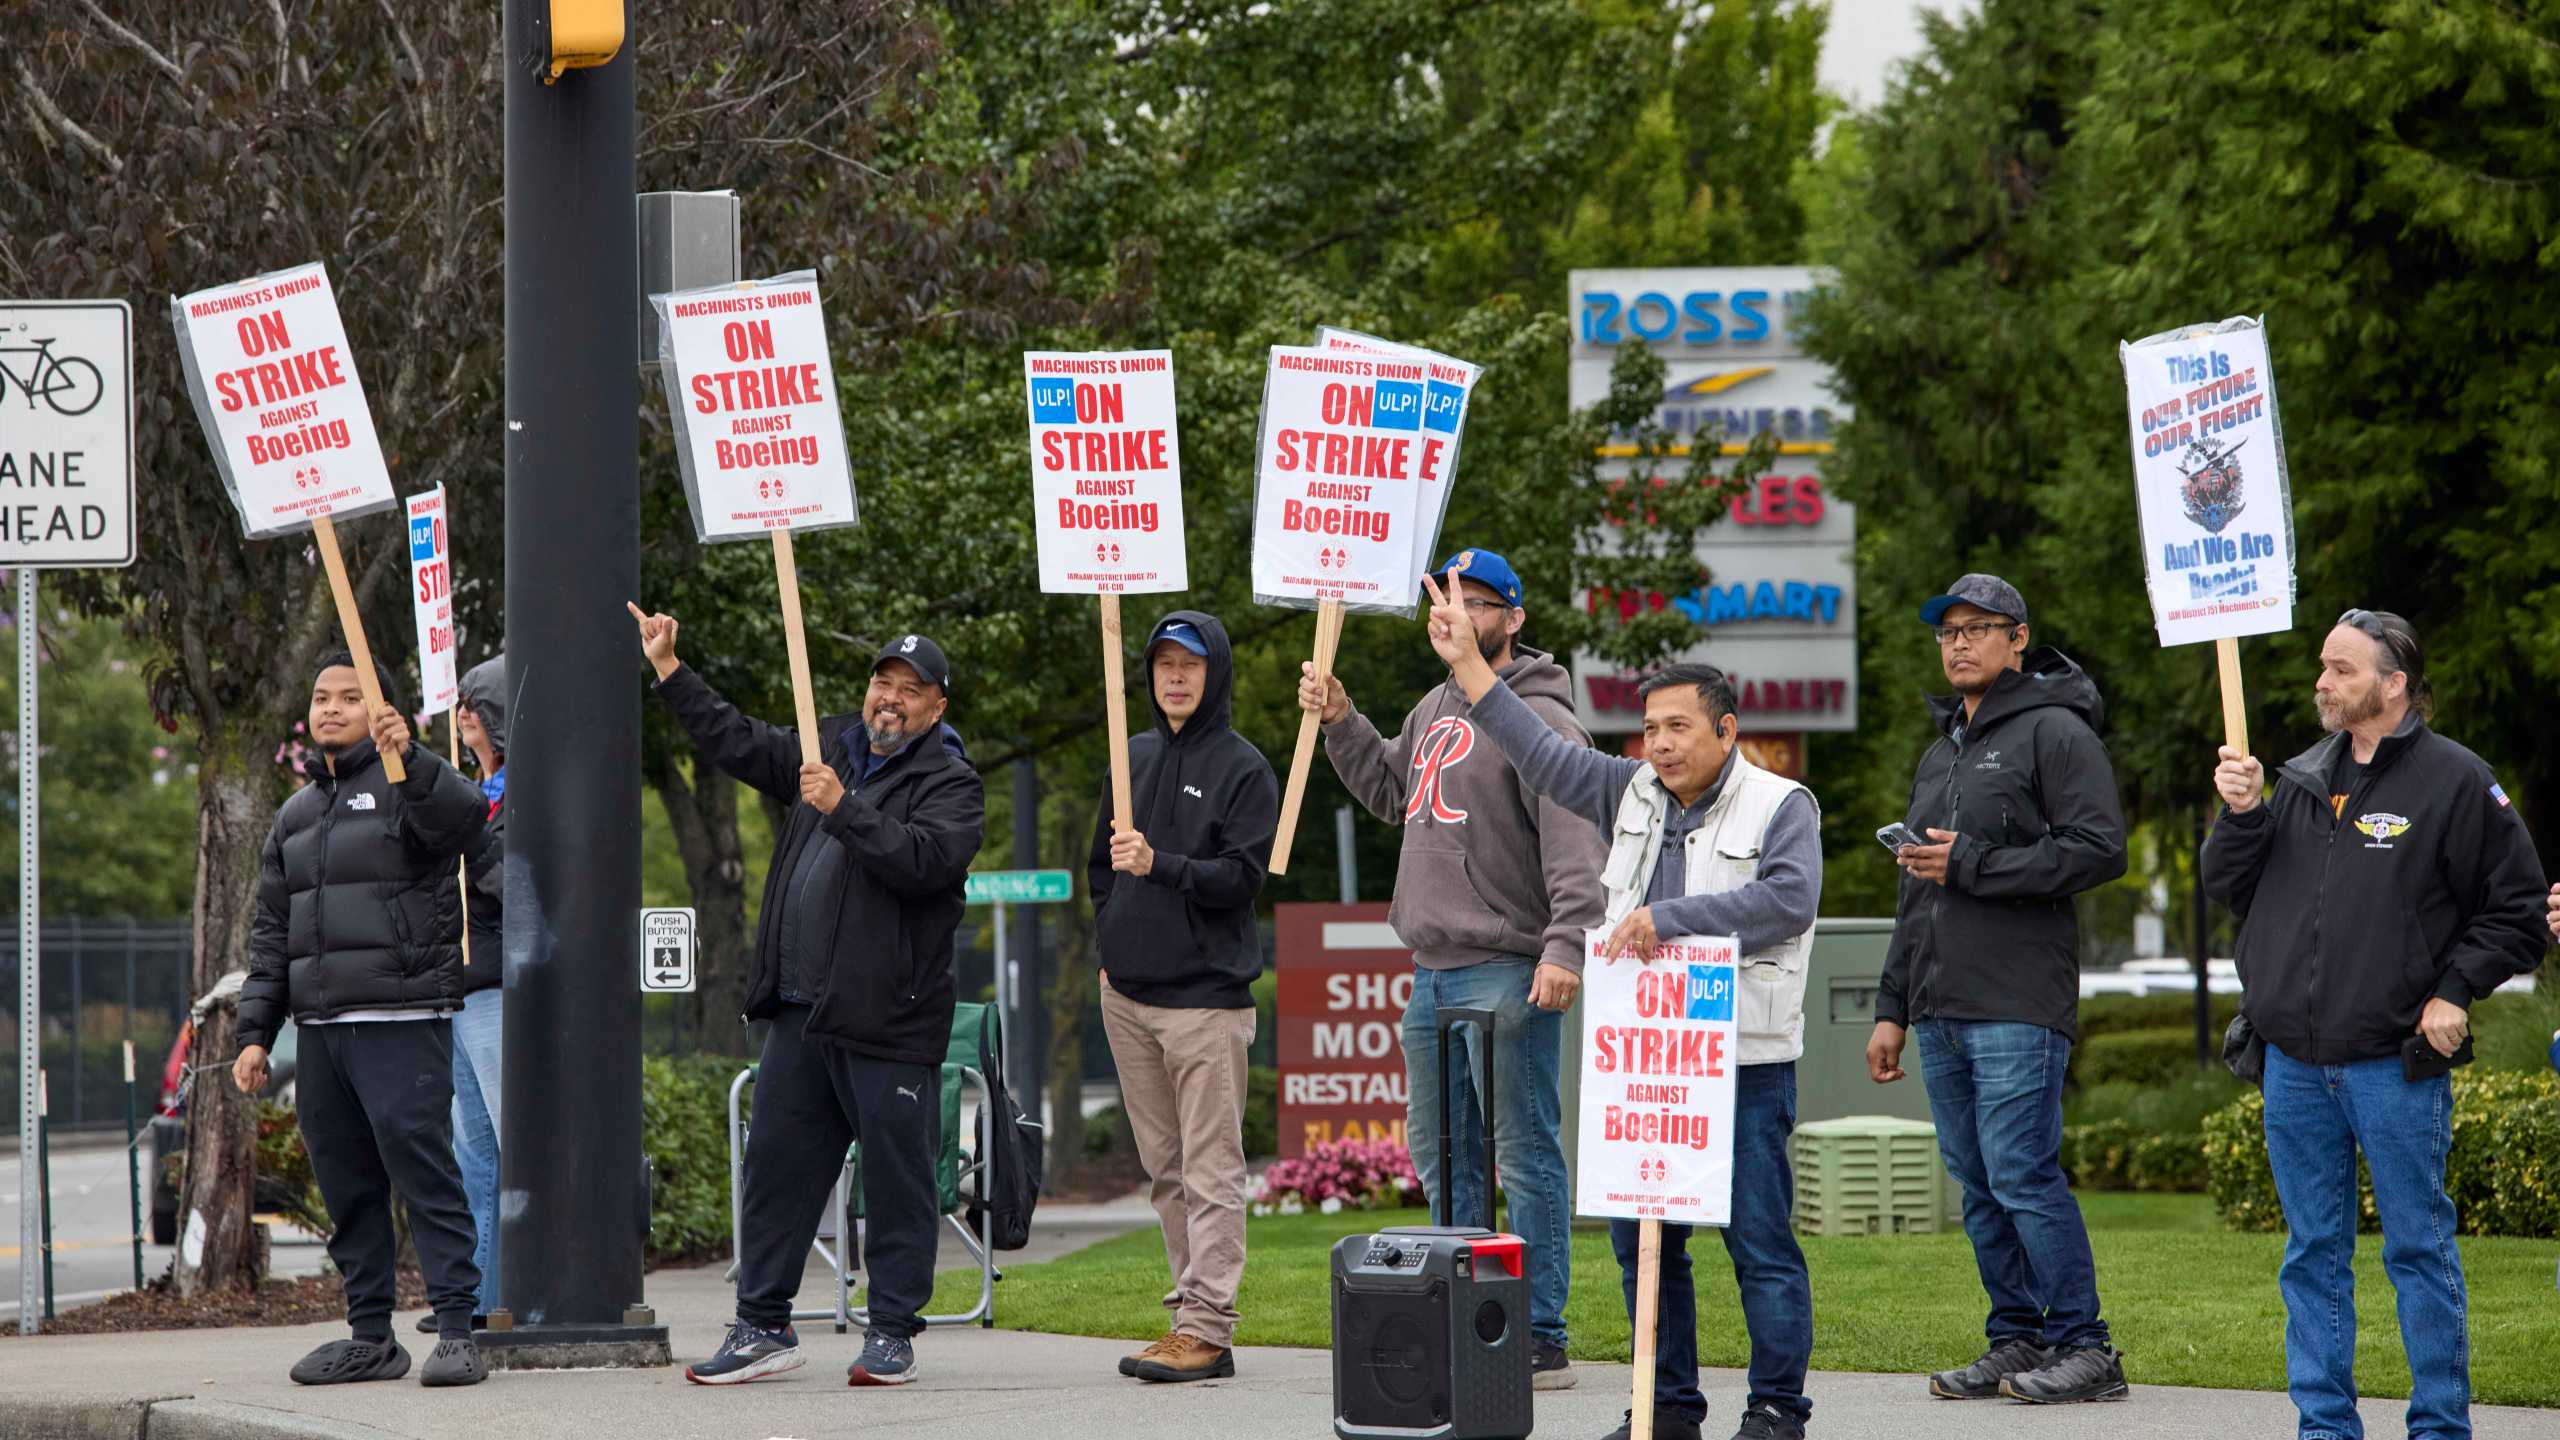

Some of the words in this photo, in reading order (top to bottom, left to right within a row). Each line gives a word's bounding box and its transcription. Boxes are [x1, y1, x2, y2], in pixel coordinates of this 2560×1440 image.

[191, 288, 273, 318] MACHINISTS
[276, 275, 321, 298] UNION
[675, 296, 764, 318] MACHINISTS
[767, 291, 812, 308] UNION
[1582, 290, 1769, 342] ROSS
[237, 310, 292, 357] ON
[723, 319, 775, 363] ON
[215, 346, 346, 413] STRIKE
[1032, 358, 1117, 374] MACHINISTS
[1121, 357, 1166, 373] UNION
[1279, 354, 1372, 376] MACHINISTS
[1376, 363, 1422, 380] UNION
[1428, 361, 1467, 384] NION
[2166, 353, 2207, 385] This
[2210, 350, 2231, 378] Is
[691, 363, 823, 414] STRIKE
[1036, 387, 1071, 407] ULP!
[1075, 382, 1124, 424] ON
[1378, 391, 1417, 413] ULP!
[2142, 397, 2183, 433] OUR
[2186, 367, 2257, 416] FUTURE
[259, 401, 319, 429] AGAINST
[1321, 383, 1374, 428] ON
[732, 414, 792, 435] AGAINST
[1664, 409, 1831, 438] FITNESS
[2144, 421, 2194, 458] OUR
[2199, 393, 2264, 438] FIGHT
[247, 419, 351, 466] Boeing
[715, 435, 820, 470] Boeing
[1042, 429, 1169, 472] STRIKE
[1276, 429, 1410, 481] STRIKE
[0, 452, 86, 488] ANE
[1075, 479, 1135, 496] AGAINST
[1307, 481, 1372, 502] AGAINST
[0, 505, 106, 542] EAD
[758, 508, 788, 518] DISTRICT
[789, 505, 810, 516] LODGE
[1058, 497, 1159, 532] Boeing
[1282, 498, 1390, 543] Boeing
[412, 526, 432, 545] ULP!
[2164, 541, 2201, 572] And
[2203, 532, 2237, 565] We
[2241, 533, 2275, 559] Are
[1094, 572, 1123, 581] DISTRICT
[1124, 572, 1144, 581] LODGE
[1146, 572, 1158, 580] 751
[1098, 582, 1125, 592] AFL-CIO
[1313, 578, 1344, 589] DISTRICT
[1345, 581, 1366, 591] LODGE
[1367, 582, 1379, 591] 751
[1316, 588, 1345, 598] AFL-CIO
[2218, 600, 2260, 614] Machinists
[1727, 676, 1846, 713] ARKET
[1405, 715, 1475, 823] R
[1183, 785, 1202, 798] FILA
[647, 927, 687, 936] BUTTON
[654, 917, 681, 926] PUSH
[657, 937, 677, 945] FOR
[1687, 945, 1732, 963] UNION
[1326, 973, 1415, 1011] SHO
[1636, 969, 1687, 1019] ON
[1691, 977, 1729, 1001] ULP!
[1595, 1025, 1725, 1078] STRIKE
[1284, 1073, 1410, 1105] RESTAU
[1626, 1083, 1689, 1105] AGAINST
[1604, 1105, 1709, 1151] Boeing
[1635, 1194, 1665, 1204] DISTRICT
[1666, 1196, 1688, 1206] LODGE
[1689, 1197, 1701, 1207] 751
